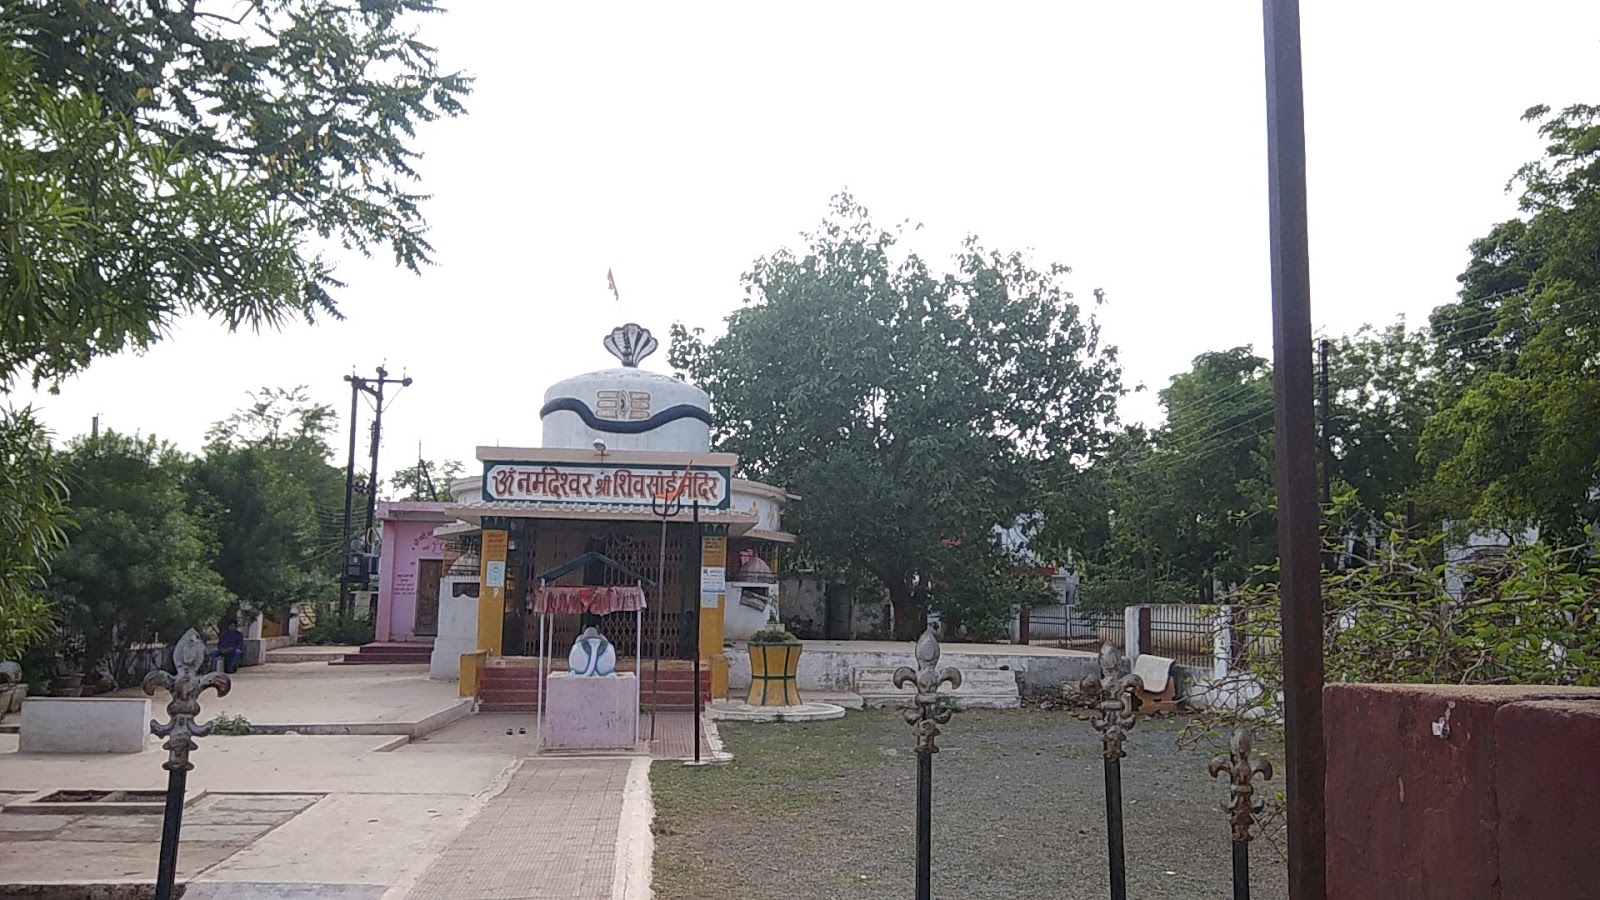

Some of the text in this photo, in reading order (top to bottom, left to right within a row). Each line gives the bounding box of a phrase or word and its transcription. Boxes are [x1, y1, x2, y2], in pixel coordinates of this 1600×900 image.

[517, 466, 595, 498] नर्मदेश्वर
[595, 471, 612, 497] श्री
[679, 471, 719, 502] मंदिर
